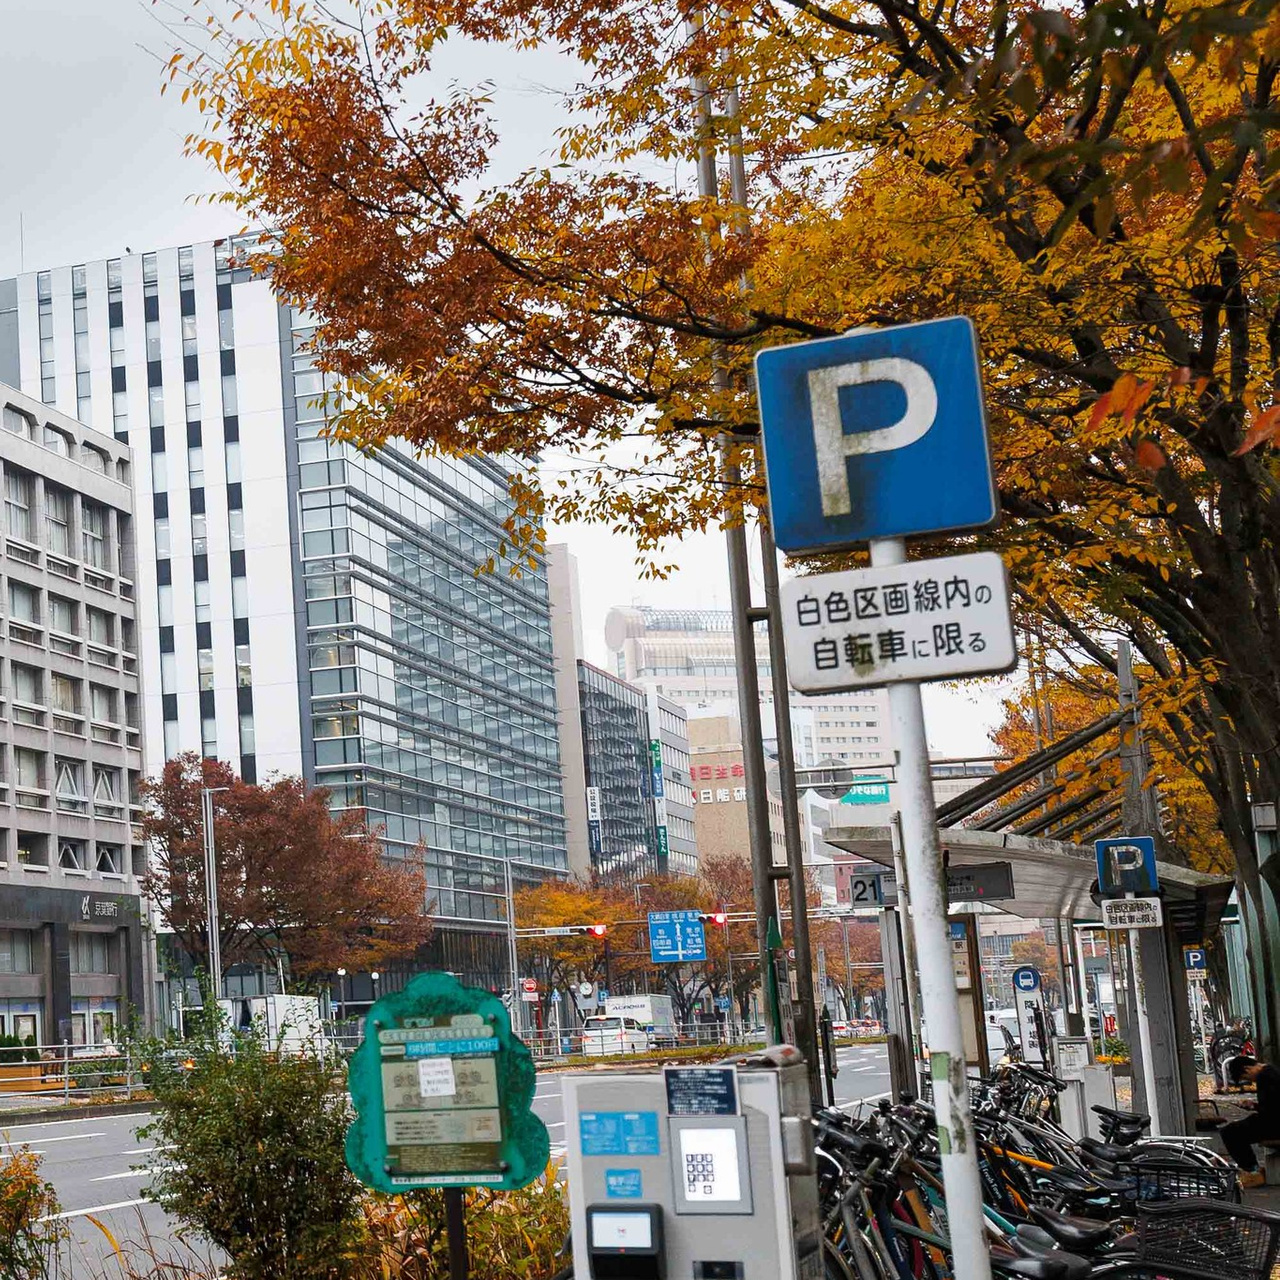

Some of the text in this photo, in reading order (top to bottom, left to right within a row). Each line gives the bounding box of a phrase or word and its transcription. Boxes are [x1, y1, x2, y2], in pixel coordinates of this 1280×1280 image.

[807, 355, 939, 518] P
[796, 575, 993, 629] 白色区画線内の
[813, 623, 989, 671] 自転車に限る
[1109, 845, 1144, 886] P
[853, 880, 878, 902] 21
[1189, 952, 1201, 966] P
